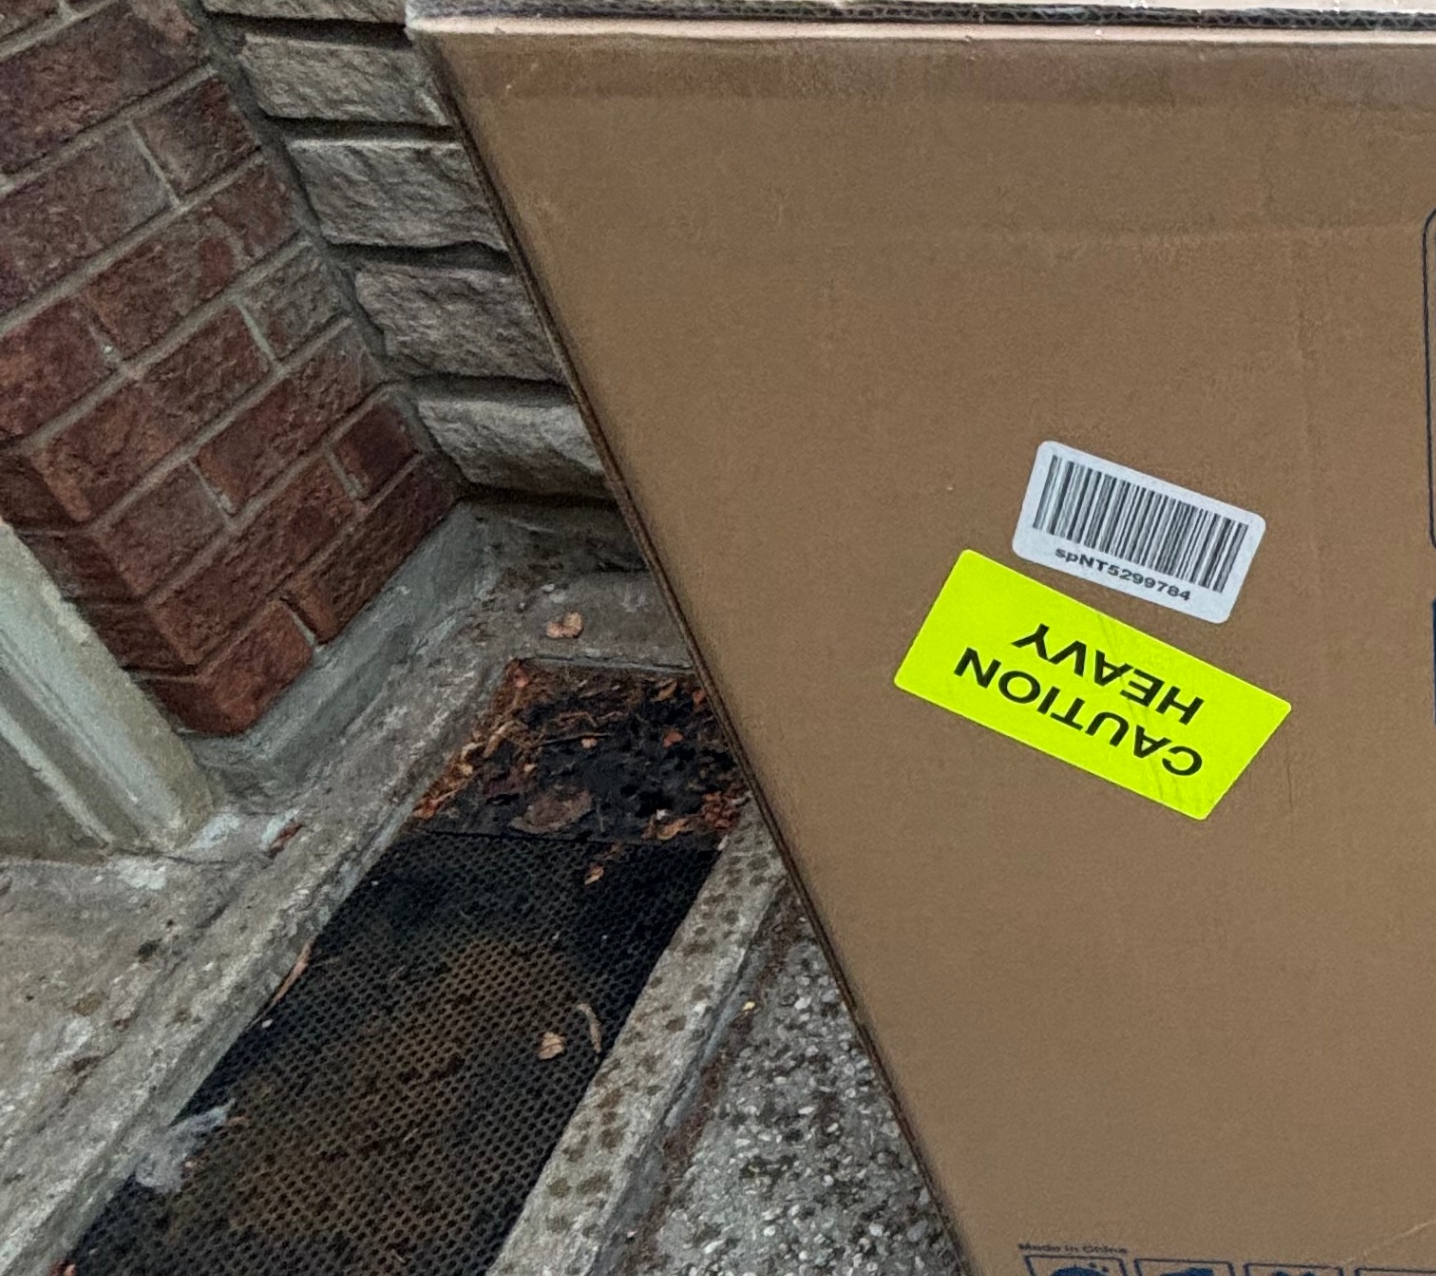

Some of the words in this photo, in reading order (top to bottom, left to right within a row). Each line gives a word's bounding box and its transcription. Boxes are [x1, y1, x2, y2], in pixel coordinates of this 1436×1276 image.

[1055, 547, 1192, 602] spNT5299784
[953, 647, 1204, 777] CAUTION
[1011, 623, 1205, 725] HEAVY
